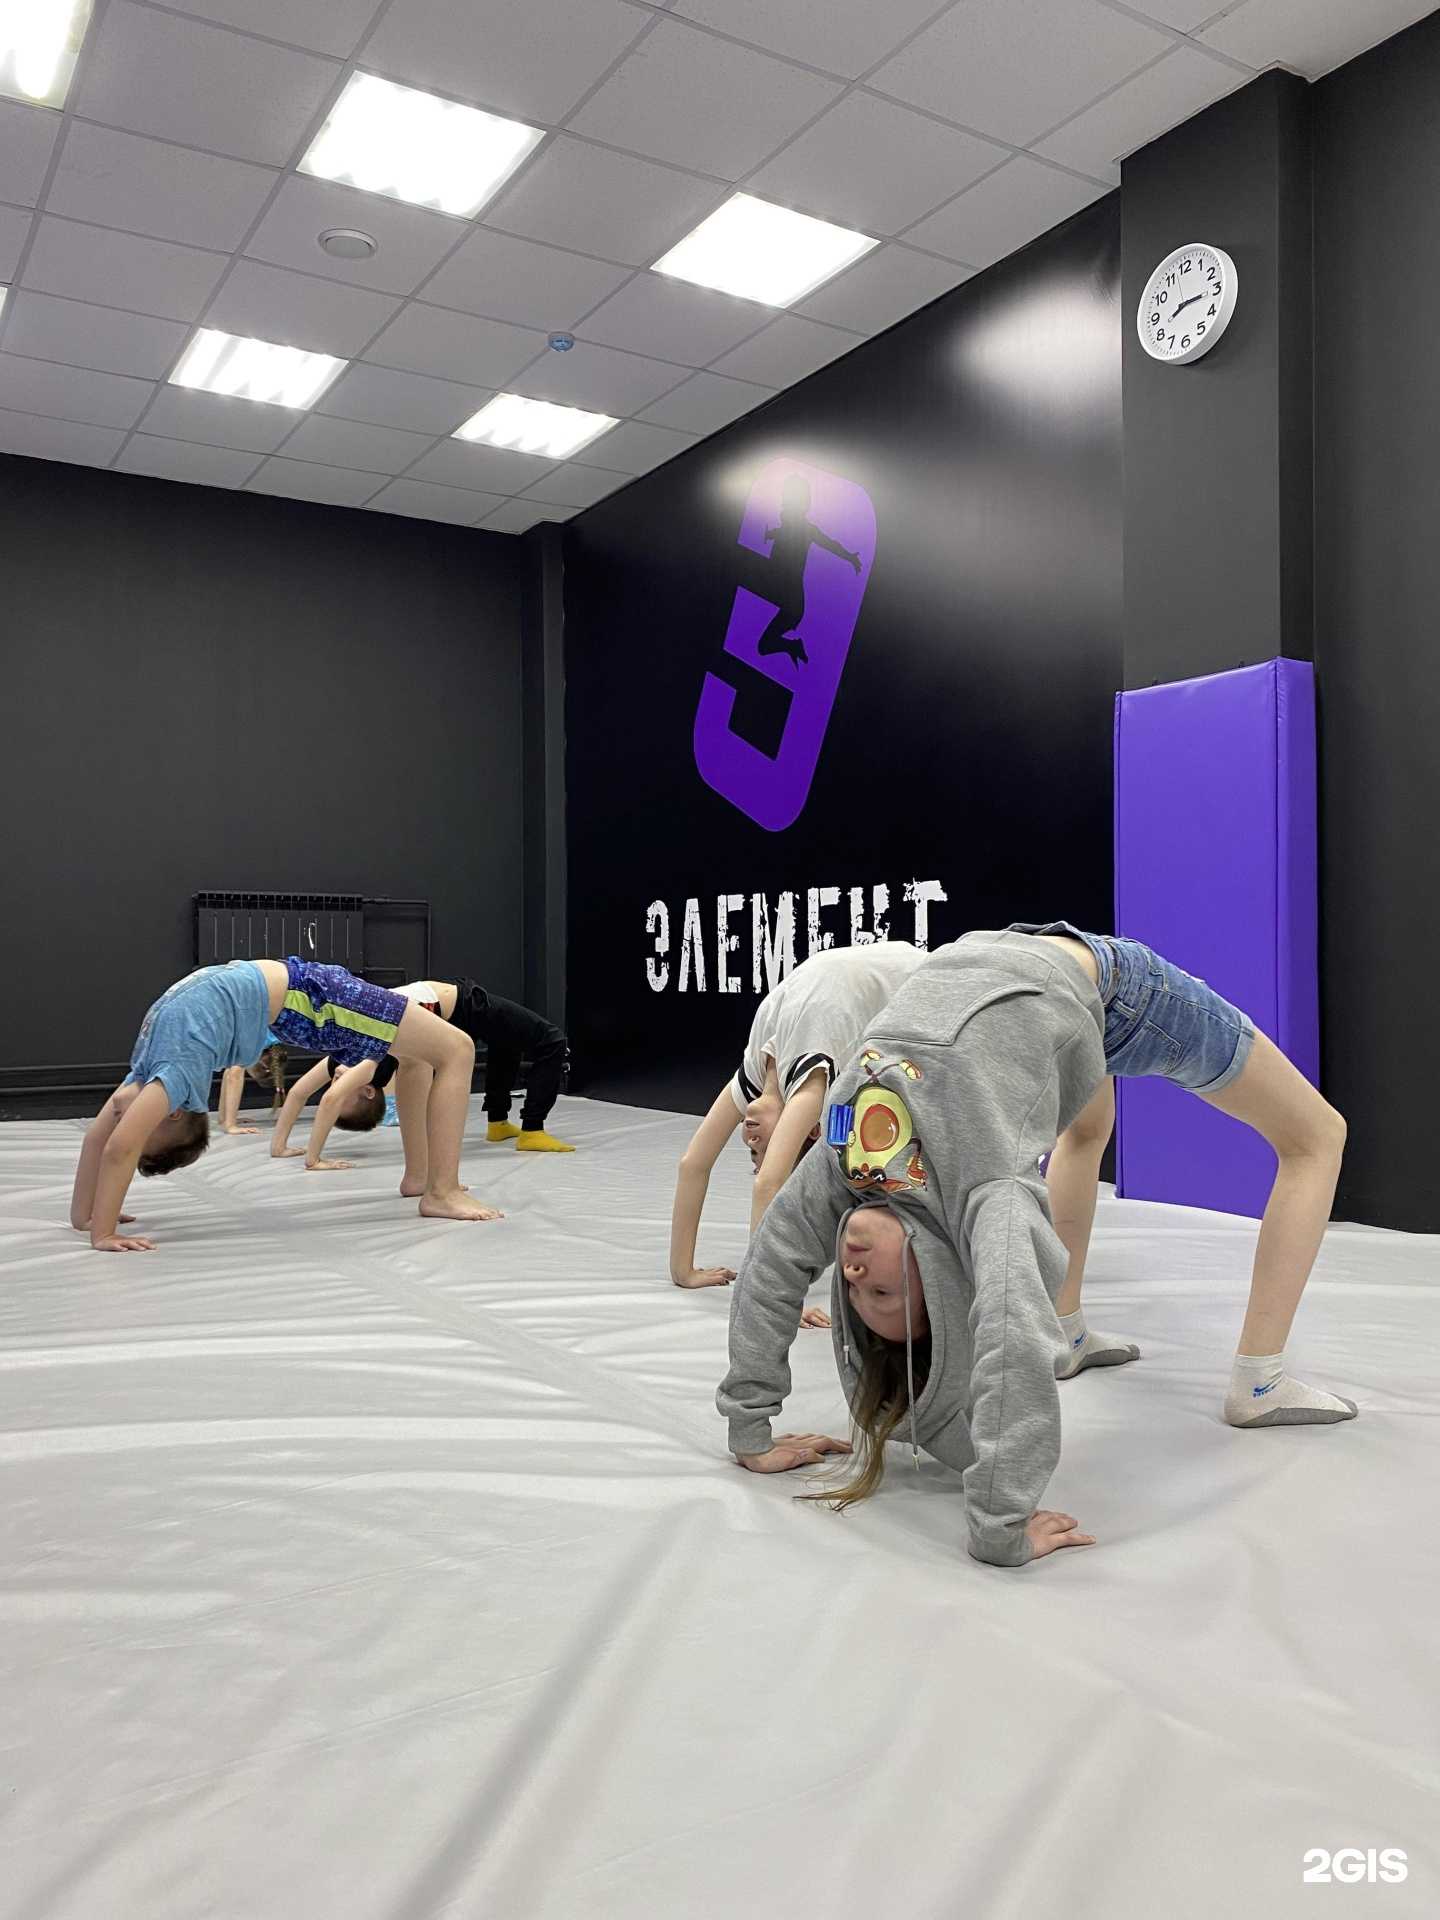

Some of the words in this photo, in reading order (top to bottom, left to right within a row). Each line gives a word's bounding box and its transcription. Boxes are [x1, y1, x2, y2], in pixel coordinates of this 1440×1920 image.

[1179, 259, 1192, 275] 12
[1198, 259, 1203, 271] 1
[1166, 273, 1175, 287] 11
[1207, 267, 1216, 281] 2
[1213, 281, 1222, 296] 3
[1154, 291, 1168, 306] 10
[1207, 304, 1216, 316] 4
[1151, 313, 1160, 325] 9
[1157, 328, 1165, 341] 8
[1197, 321, 1206, 335] 5
[1168, 335, 1175, 349] 7
[1181, 335, 1190, 348] 6
